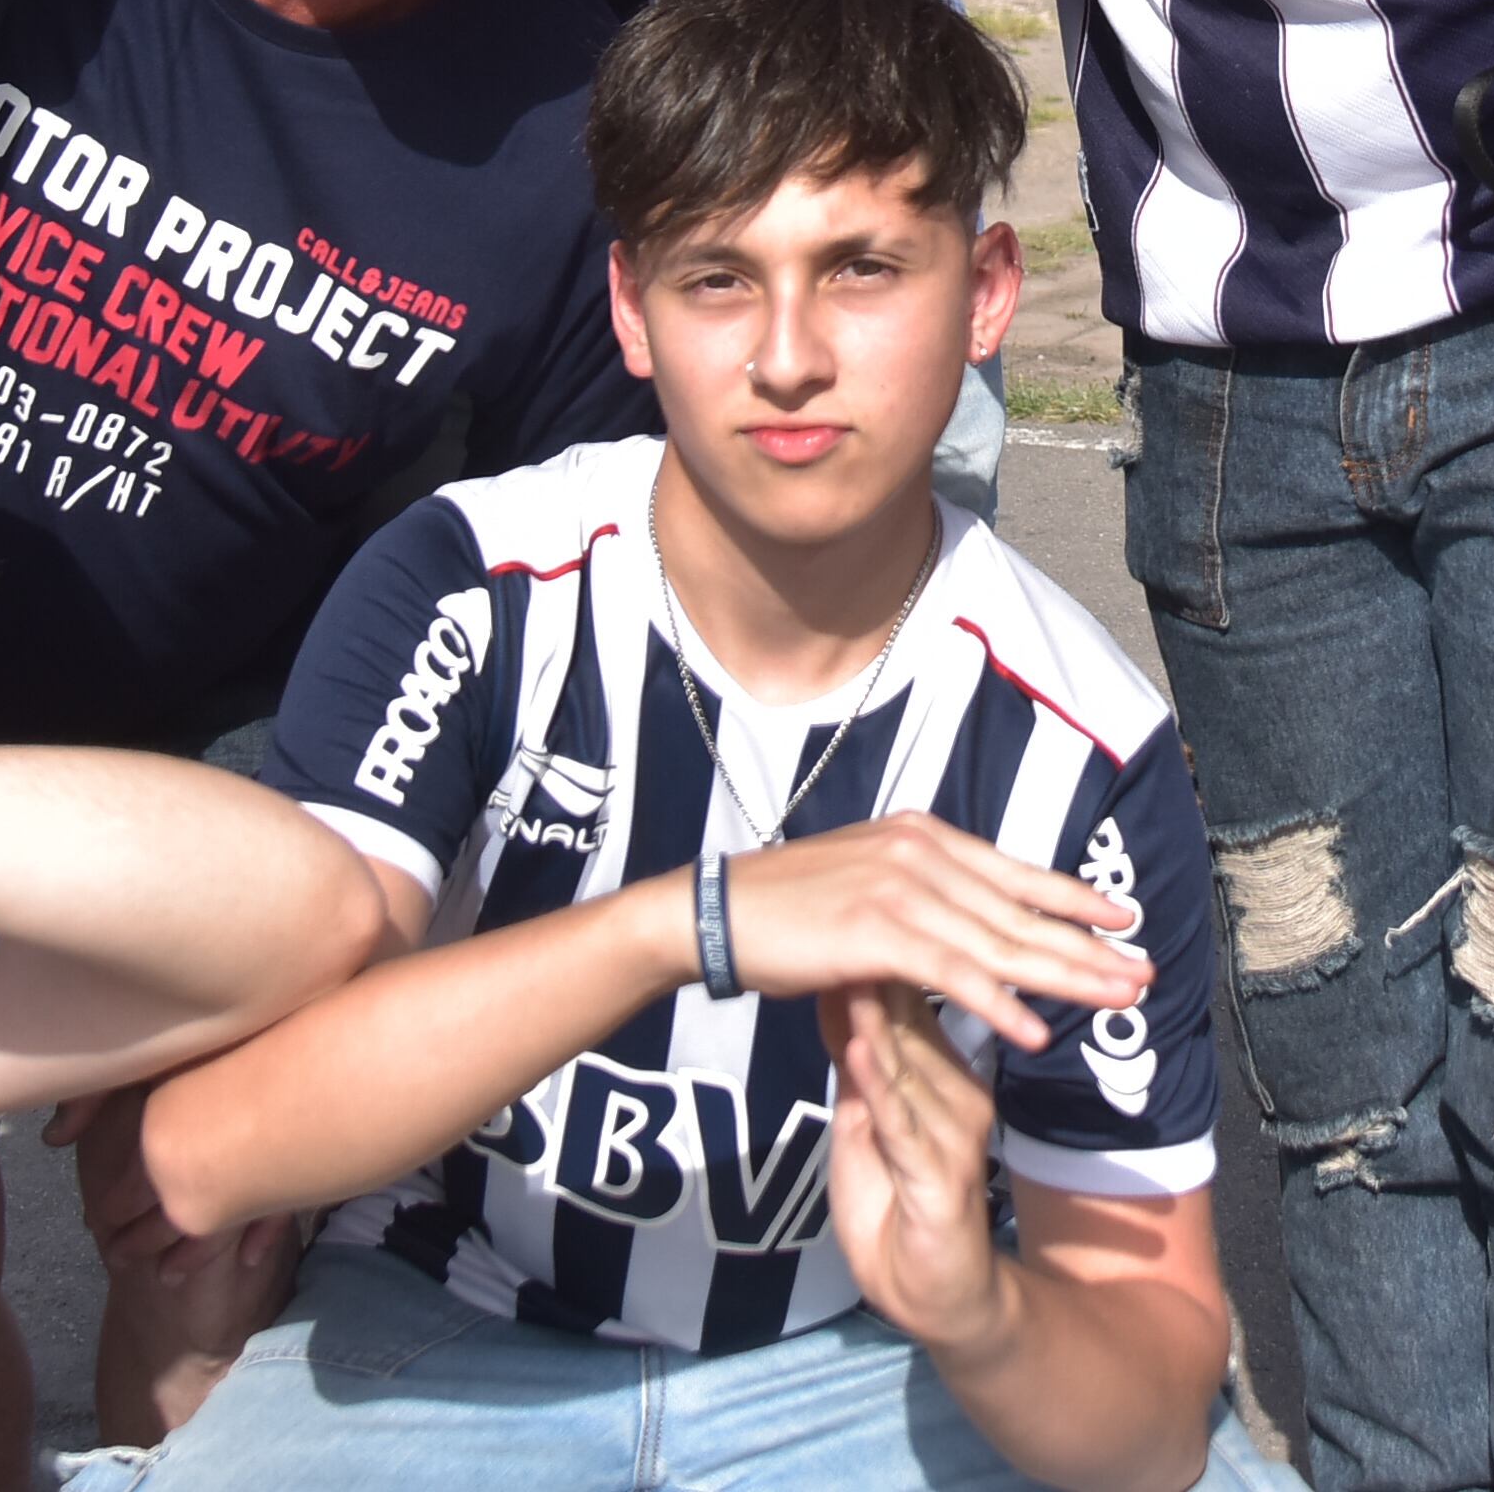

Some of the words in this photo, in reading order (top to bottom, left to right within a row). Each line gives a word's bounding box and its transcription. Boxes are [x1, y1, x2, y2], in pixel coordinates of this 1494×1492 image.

[101, 263, 266, 390] CREW
[144, 194, 457, 387] PROJECT
[296, 226, 468, 331] CALL&JEANS
[354, 615, 471, 808] PROACO
[464, 1051, 834, 1258] BV
